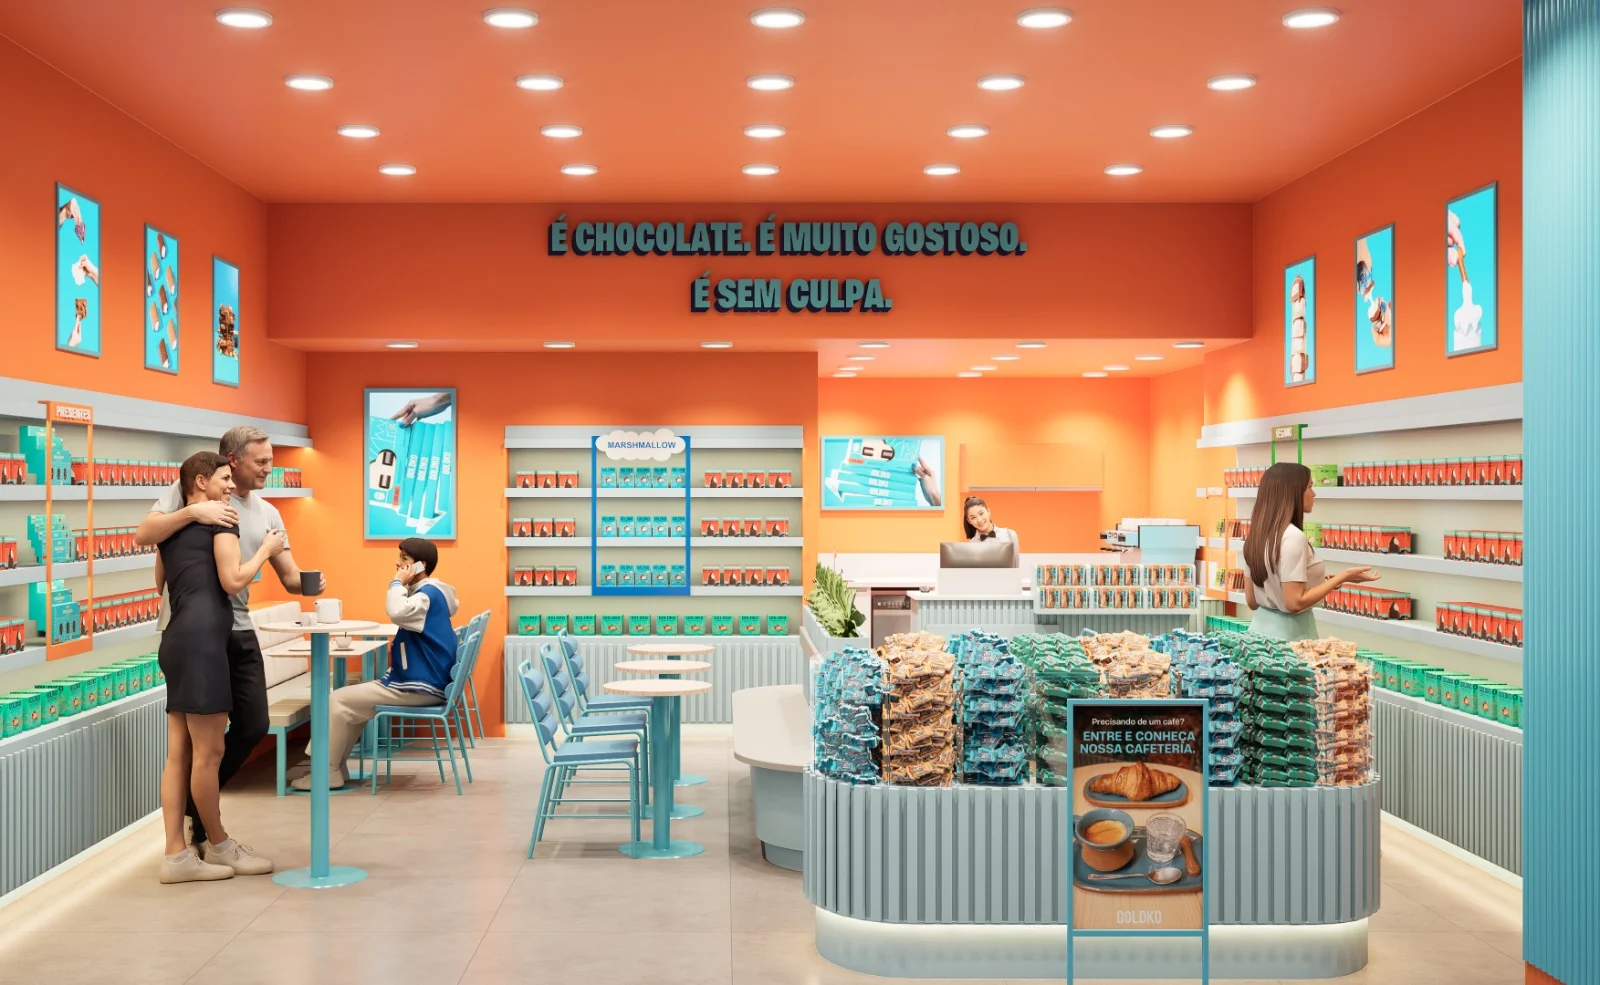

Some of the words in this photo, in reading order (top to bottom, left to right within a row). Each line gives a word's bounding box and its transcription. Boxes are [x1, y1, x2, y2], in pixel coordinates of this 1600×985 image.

[548, 214, 568, 255] É
[573, 221, 751, 255] CHOCOLATE.
[757, 214, 776, 255] É
[780, 221, 877, 255] MUITO
[883, 221, 1027, 255] GOSTOSO.
[691, 271, 711, 312] É
[715, 279, 781, 312] SEM
[787, 279, 893, 312] CULPA.
[56, 406, 91, 420] PRESENTES
[607, 441, 676, 449] MARSHMALLOW
[1091, 718, 1136, 726] Precisando
[1137, 718, 1148, 726] de
[1163, 718, 1185, 726] café?
[1083, 731, 1123, 741] ENTRE
[1125, 731, 1133, 741] E
[1135, 731, 1196, 744] CONHEÇA
[1080, 743, 1123, 754] NOSSA
[1125, 744, 1196, 754] CAFETERIA.
[1117, 910, 1162, 925] GOLDKO
